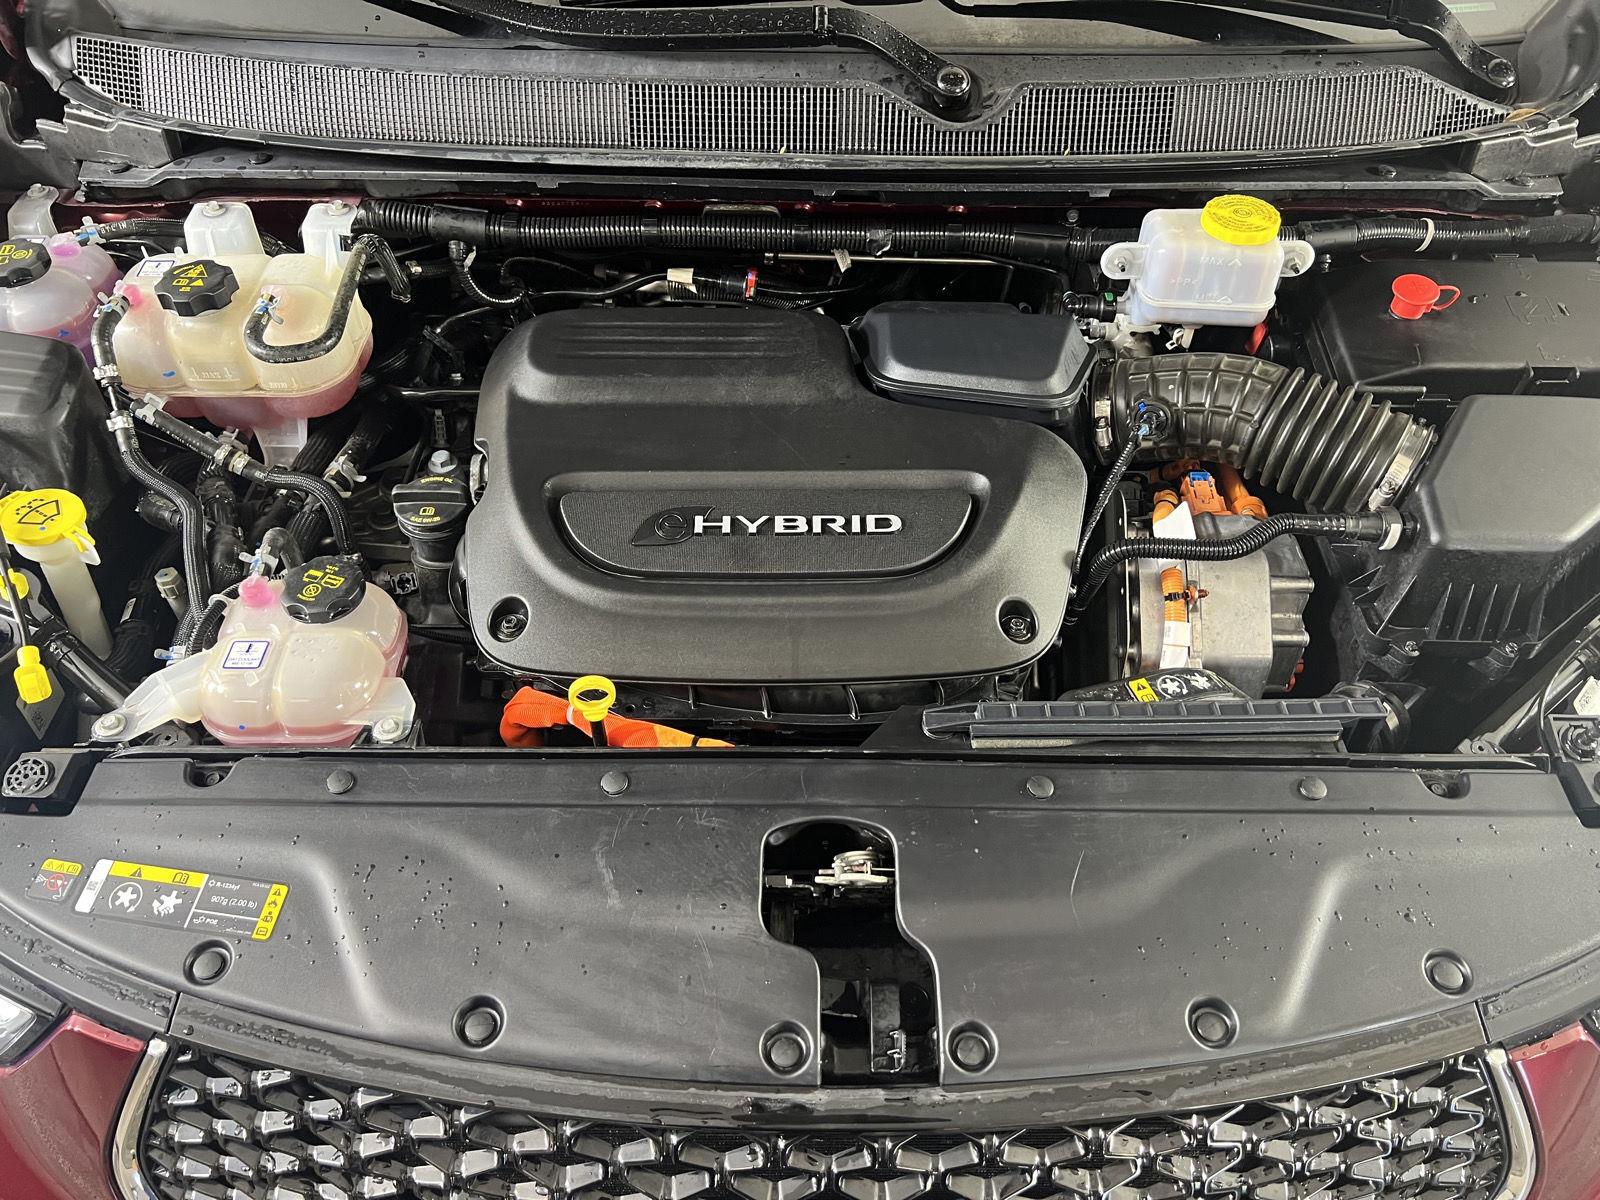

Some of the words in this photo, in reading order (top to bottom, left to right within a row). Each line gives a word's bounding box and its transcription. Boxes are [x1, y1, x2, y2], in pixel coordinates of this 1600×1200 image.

[693, 514, 902, 537] HYBRID
[210, 895, 228, 905] 907g
[229, 898, 247, 907] (2.00
[247, 900, 258, 910] lb)
